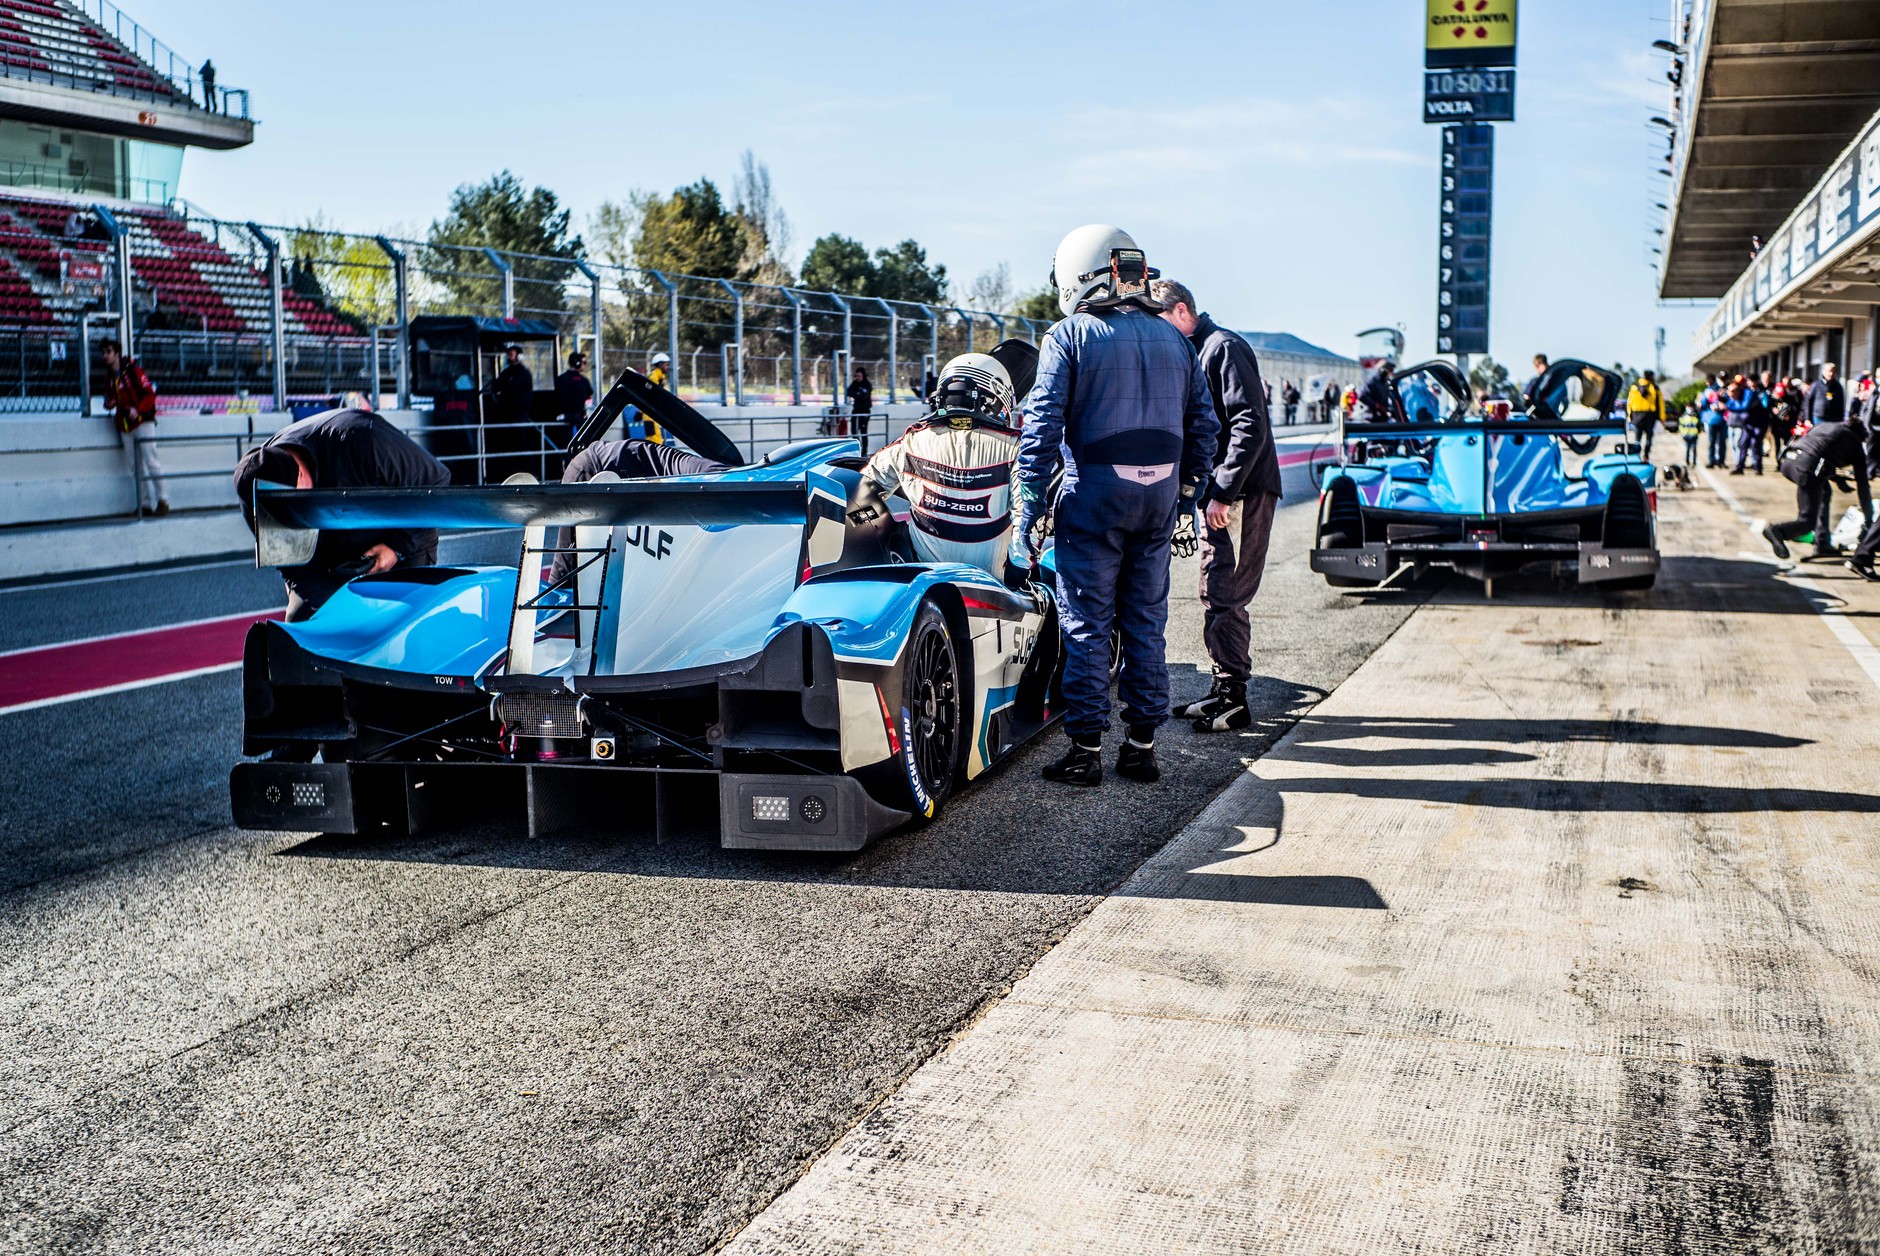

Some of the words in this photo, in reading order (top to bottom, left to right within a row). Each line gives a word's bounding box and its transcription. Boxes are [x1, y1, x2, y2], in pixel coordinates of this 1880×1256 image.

[1427, 101, 1473, 113] VOLTA
[1445, 130, 1454, 145] 1
[1444, 153, 1454, 168] 2
[1443, 176, 1454, 191] 3
[1442, 199, 1454, 214] 4
[1442, 222, 1453, 237] 5
[1441, 245, 1453, 260] 6
[1440, 268, 1452, 283] 7
[1440, 290, 1451, 306] 8
[1440, 313, 1451, 329] 9
[924, 494, 984, 512] SUB-ZERO
[434, 676, 453, 685] TOW
[903, 717, 927, 804] MICHELIN
